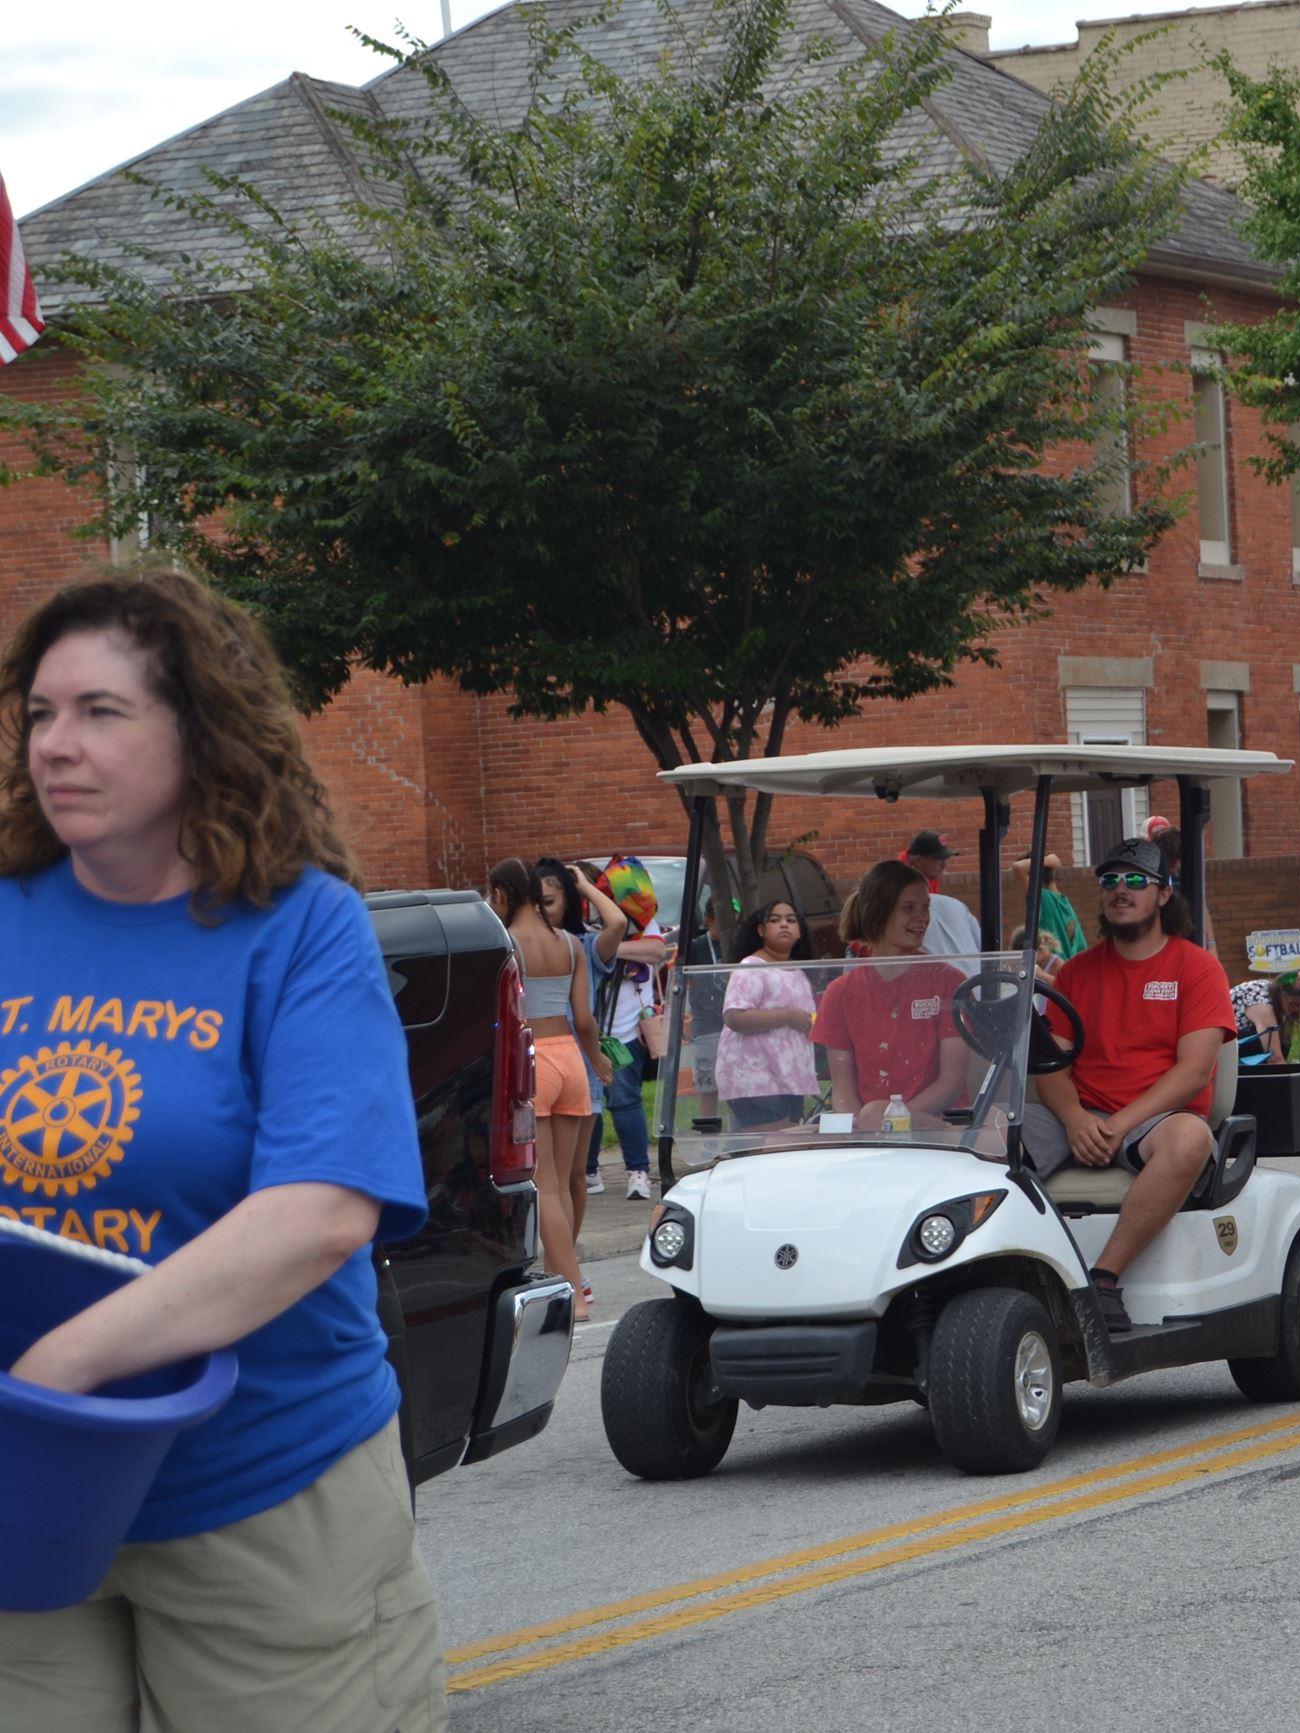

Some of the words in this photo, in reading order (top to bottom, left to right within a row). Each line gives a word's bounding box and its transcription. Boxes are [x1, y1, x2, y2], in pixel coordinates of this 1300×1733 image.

[47, 996, 223, 1048] MARYS
[45, 1055, 109, 1073] ROTARY
[0, 1132, 111, 1179] INTERNATIONAL
[1218, 1221, 1235, 1237] 29
